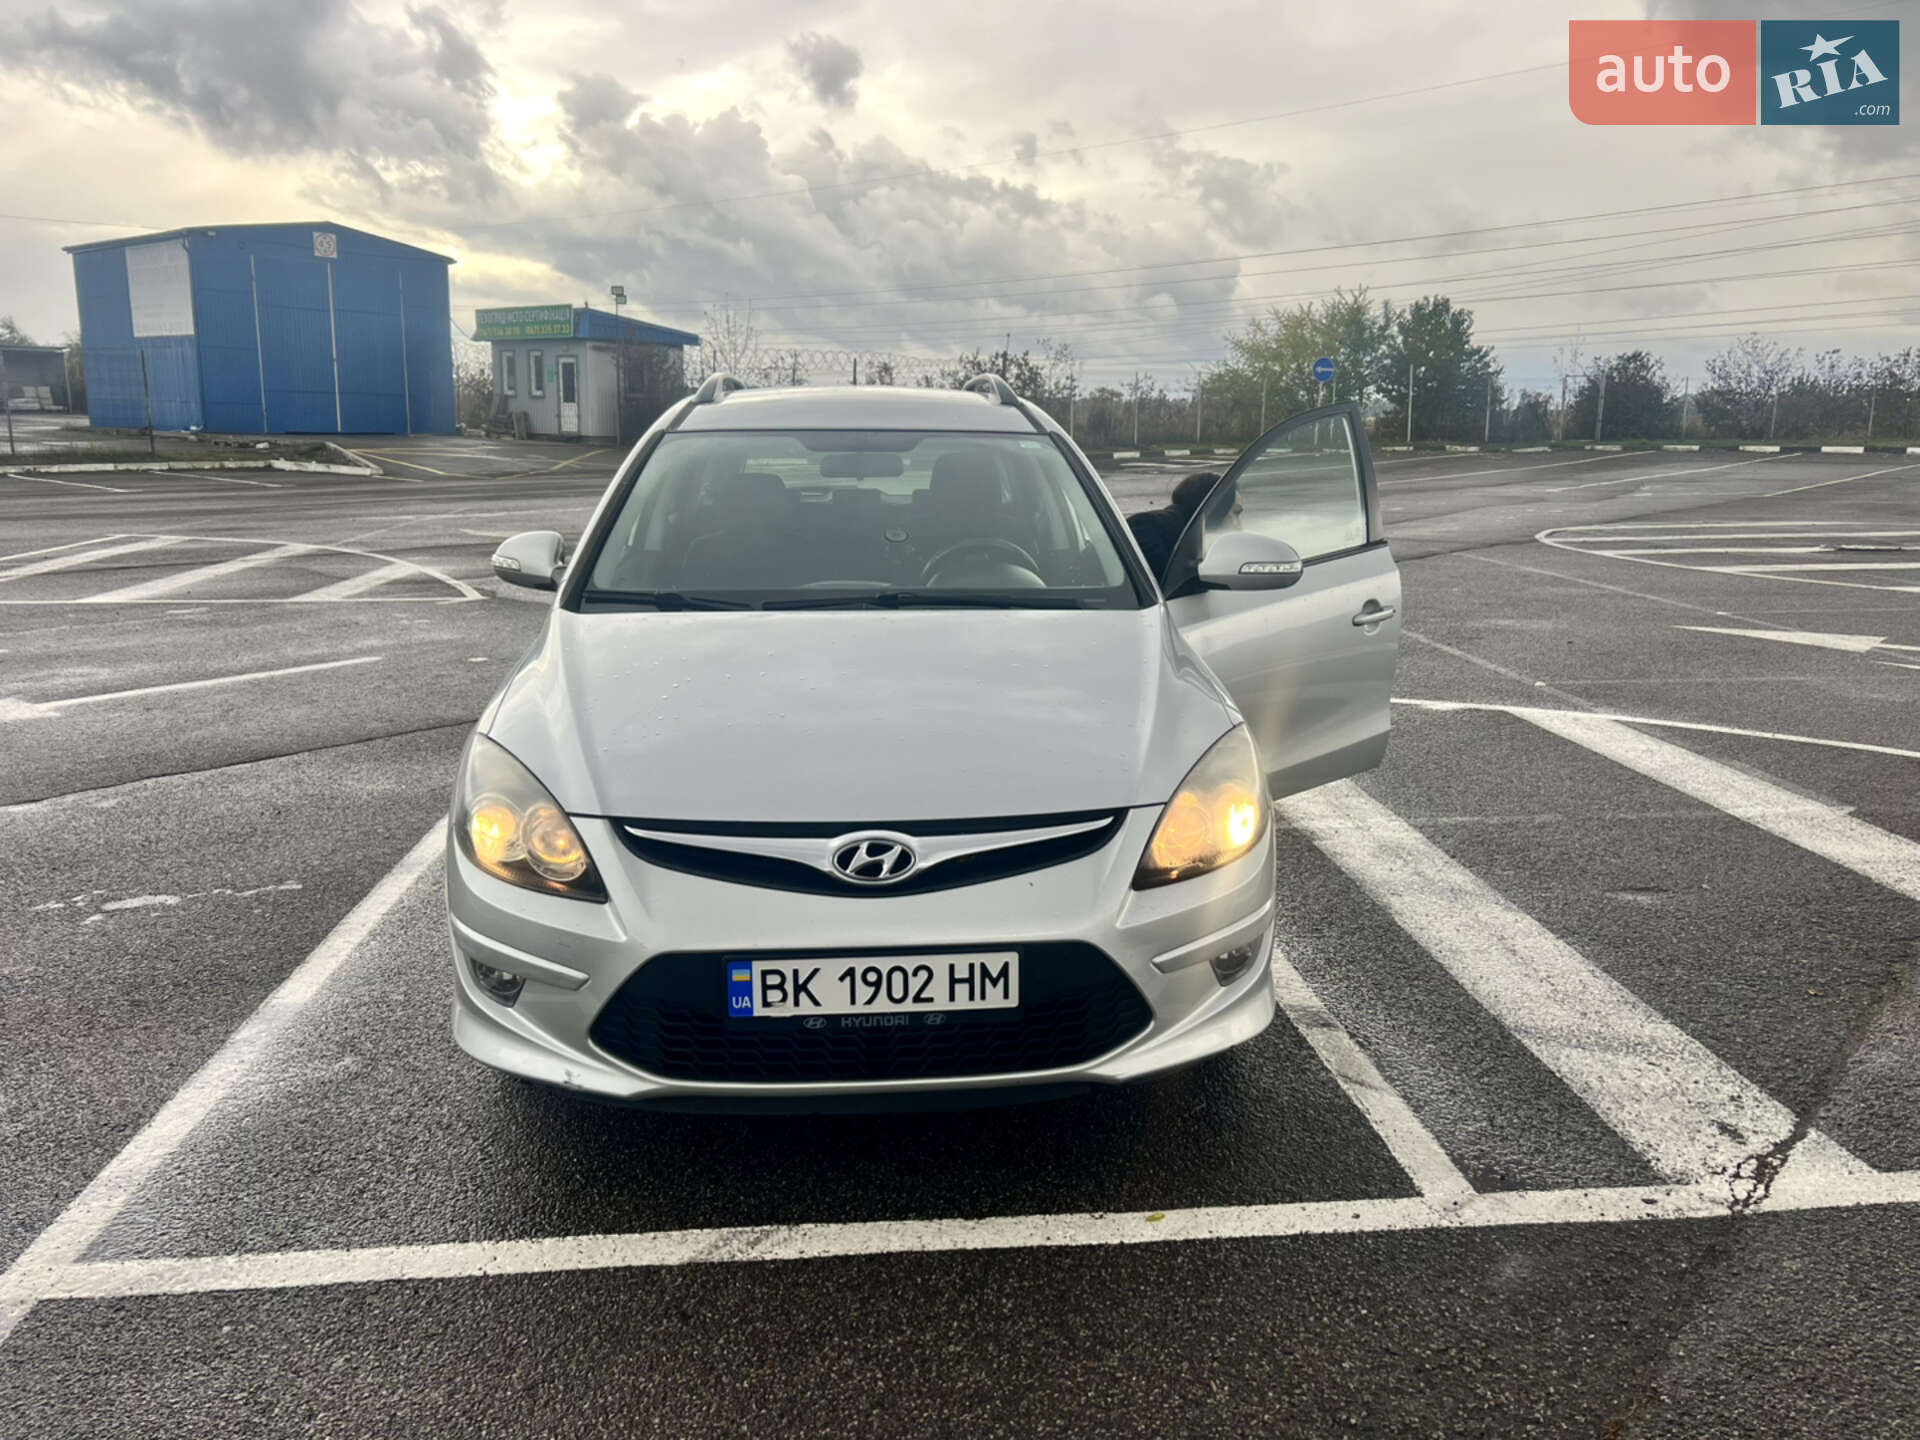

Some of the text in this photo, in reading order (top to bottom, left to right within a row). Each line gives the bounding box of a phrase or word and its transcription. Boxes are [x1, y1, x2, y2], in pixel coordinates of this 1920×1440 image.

[761, 961, 1009, 1008] BK 1902 HM
[732, 996, 751, 1009] UA
[841, 1015, 909, 1028] HYUNDAI
